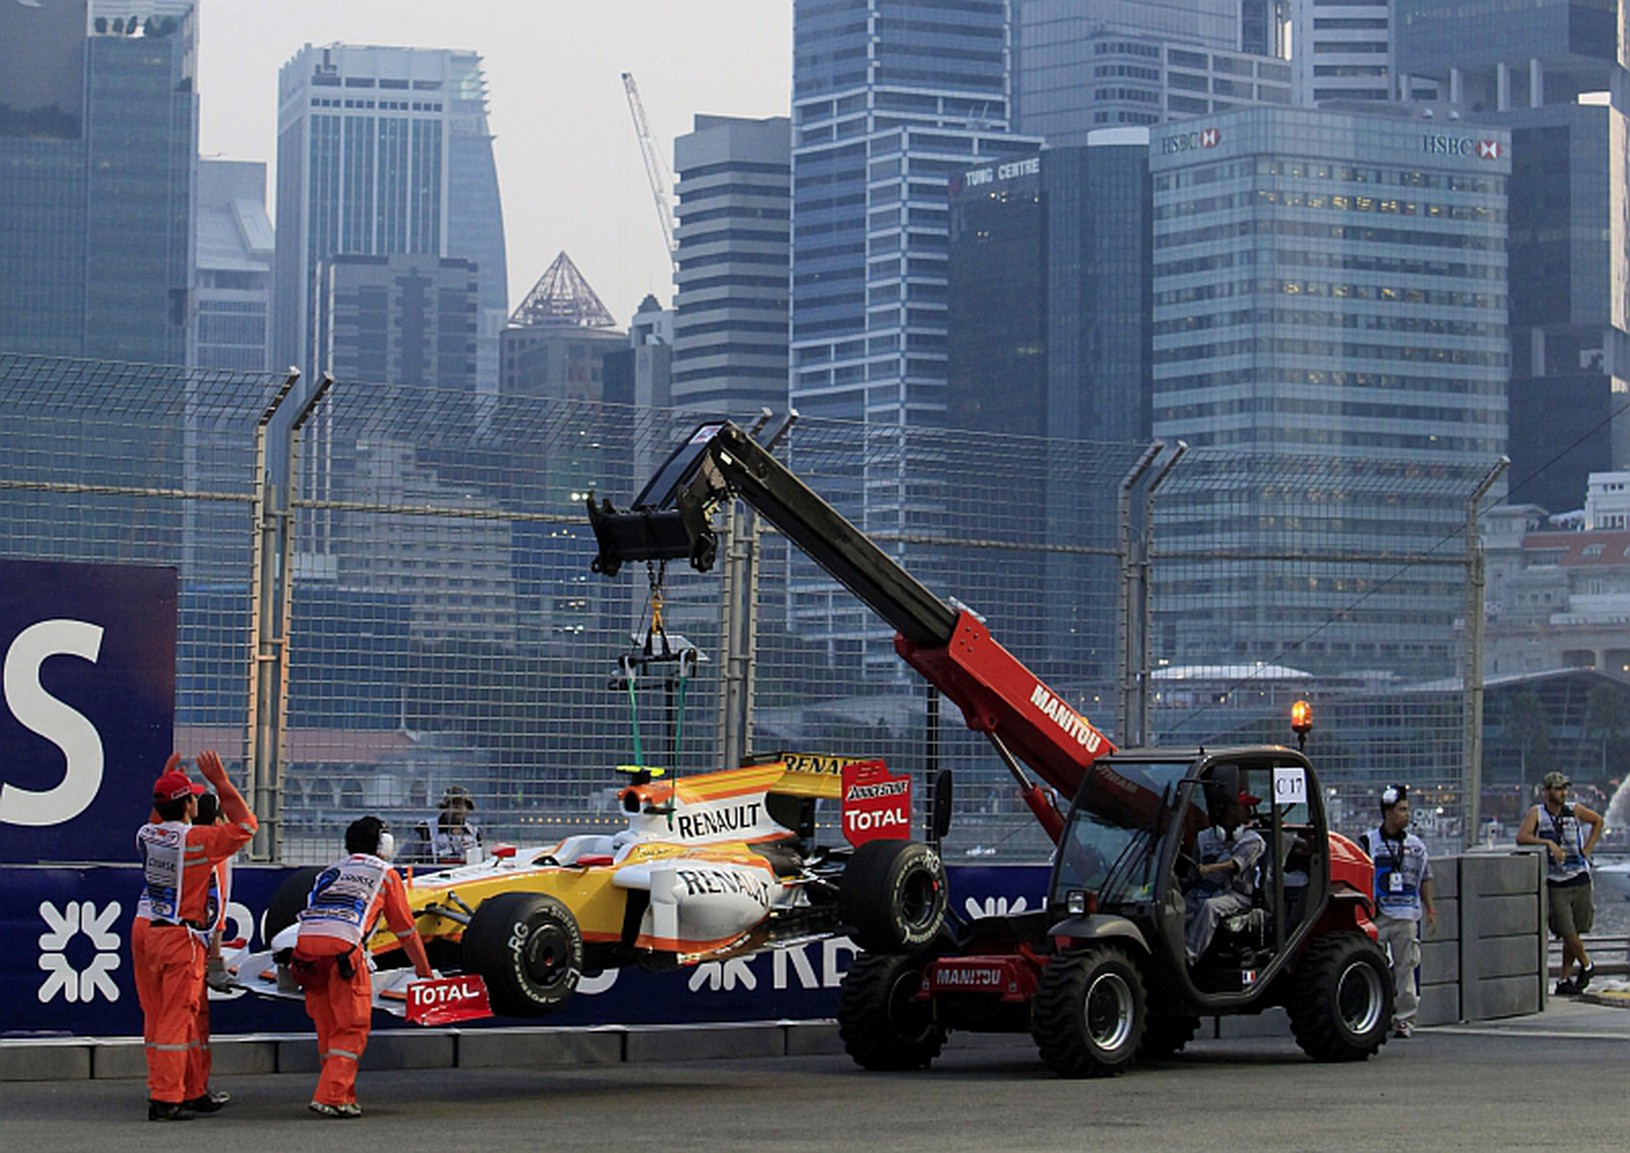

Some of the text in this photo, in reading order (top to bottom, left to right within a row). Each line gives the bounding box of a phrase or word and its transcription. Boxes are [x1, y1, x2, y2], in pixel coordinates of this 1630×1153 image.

[1162, 132, 1198, 155] HSBC
[1423, 135, 1473, 157] HSBC
[965, 158, 1040, 186] TUNG CENTRE
[1030, 684, 1101, 754] MANITOU
[784, 755, 862, 775] RENA
[1276, 778, 1303, 795] C 17
[678, 802, 761, 839] RENAULT
[845, 808, 908, 832] TOTAL
[676, 869, 769, 908] RENAULT
[937, 968, 1001, 985] MANITOU
[411, 982, 479, 1005] TOTAL
